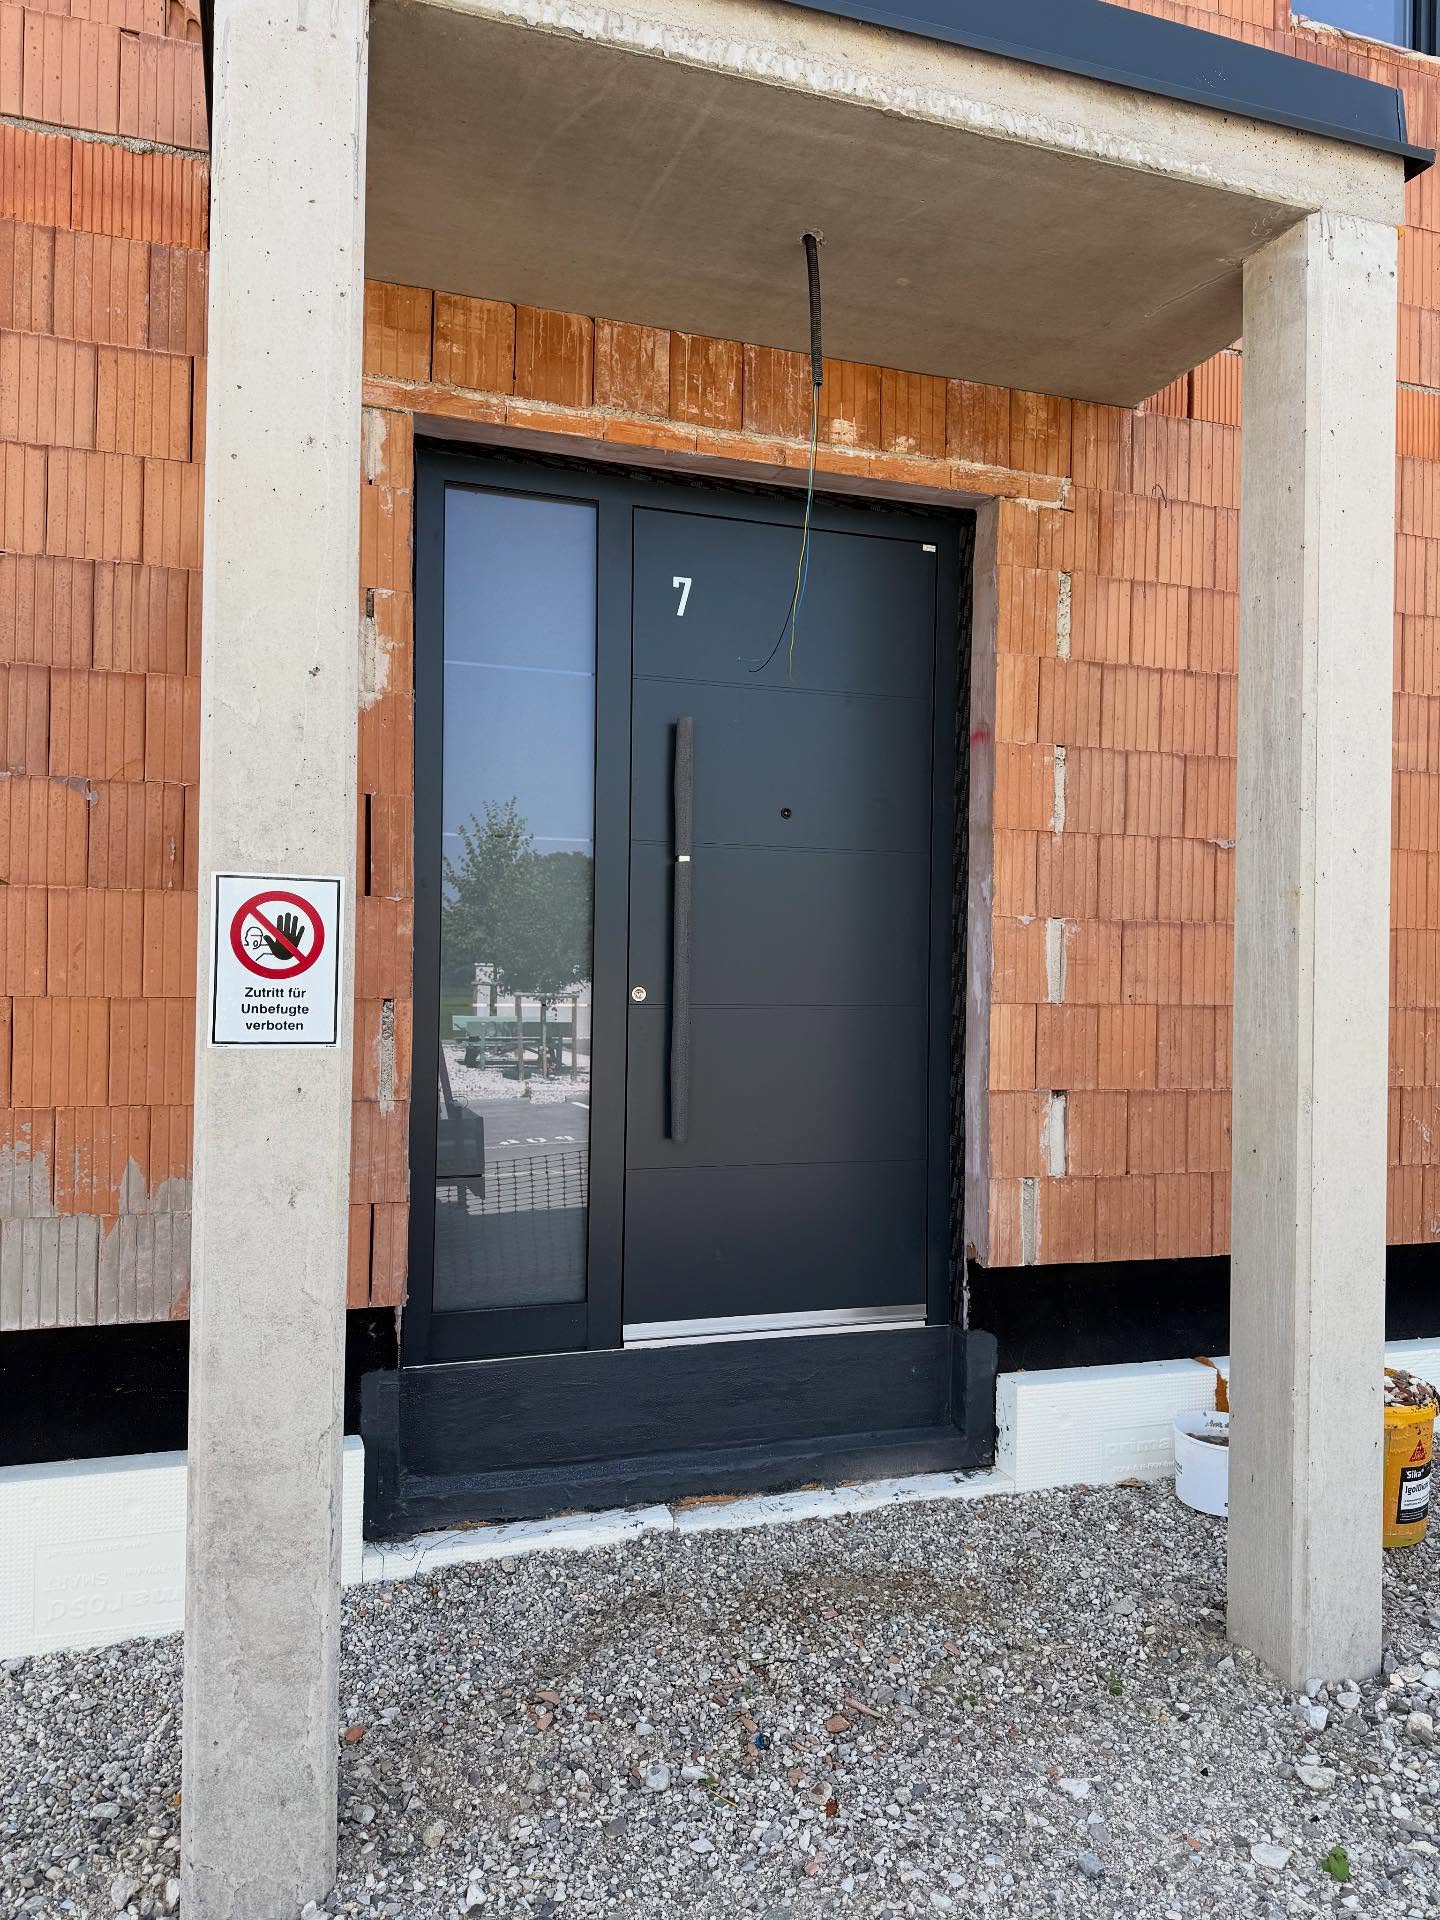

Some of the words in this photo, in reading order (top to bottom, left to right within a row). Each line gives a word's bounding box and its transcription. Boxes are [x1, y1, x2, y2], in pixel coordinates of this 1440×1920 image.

[673, 576, 692, 616] 7
[245, 987, 284, 997] Zutritt
[289, 988, 306, 998] für
[242, 1004, 309, 1016] Unbefugte
[246, 1020, 303, 1030] verboten
[1406, 1470, 1421, 1479] Sika
